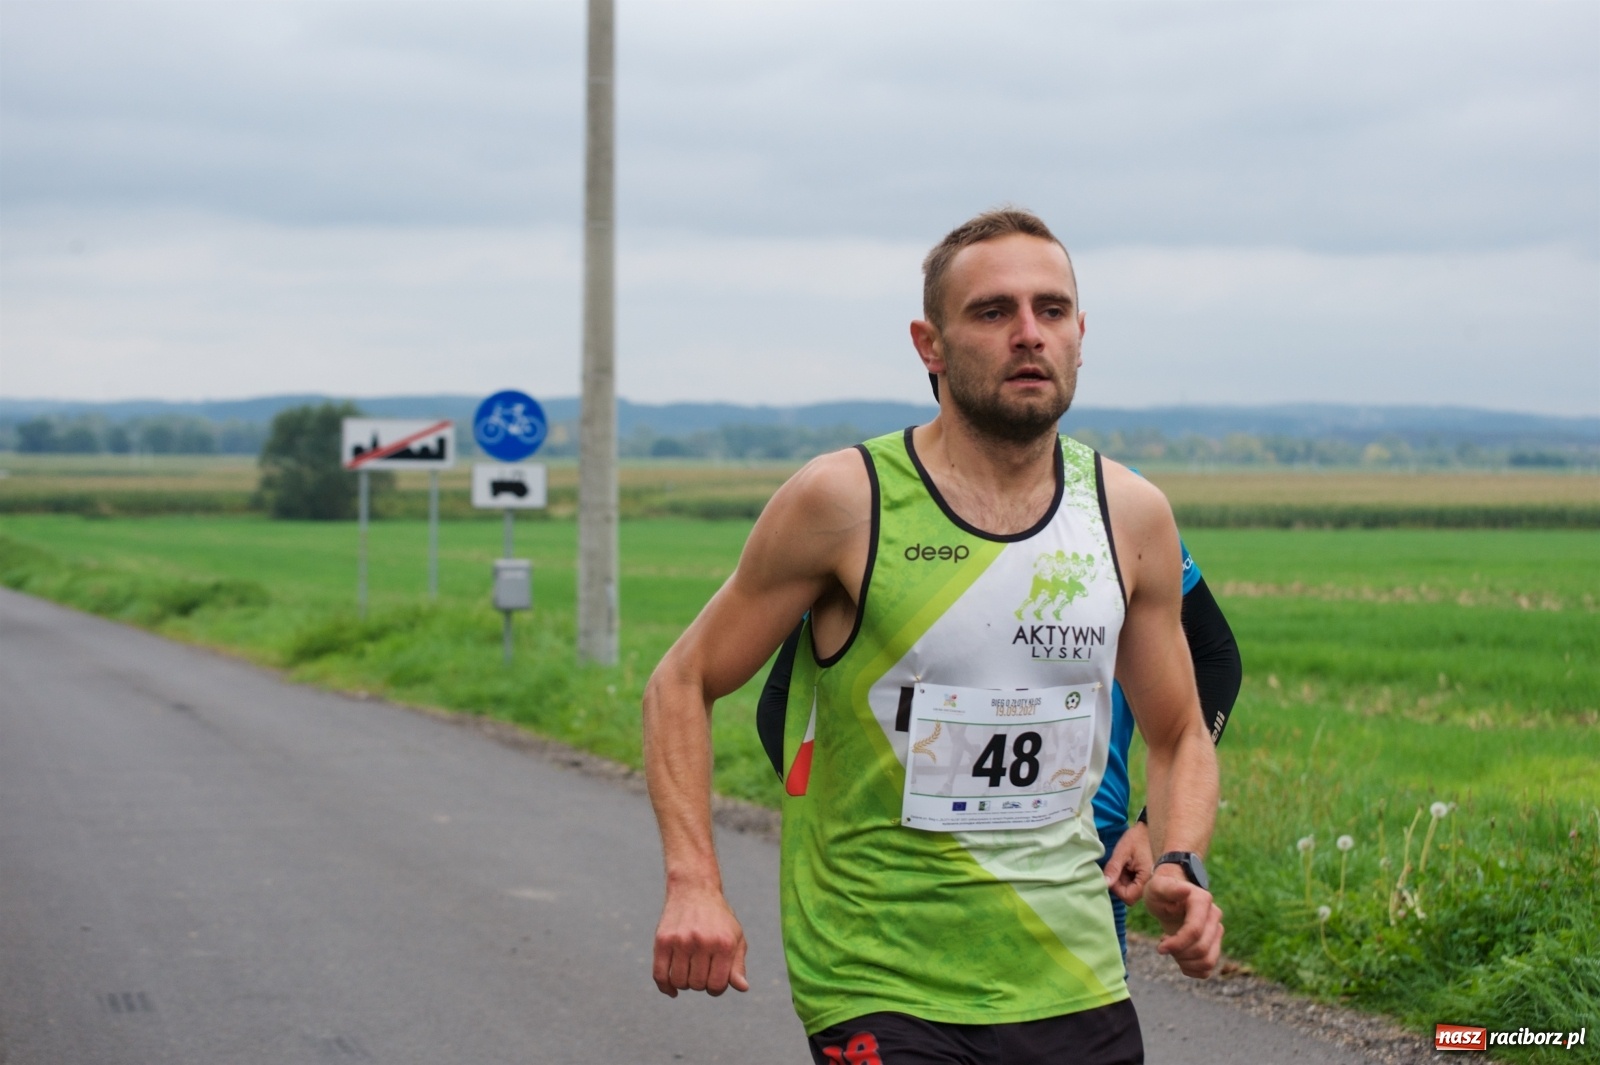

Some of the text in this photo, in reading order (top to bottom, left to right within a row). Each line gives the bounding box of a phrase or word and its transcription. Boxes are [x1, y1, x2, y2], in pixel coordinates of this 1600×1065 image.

[904, 543, 970, 563] deep
[1012, 625, 1105, 645] AKTYWNI
[1031, 646, 1091, 659] LYSKI
[991, 698, 1005, 707] BIEG
[995, 705, 1036, 716] 19.09.2021
[971, 731, 1043, 788] 48
